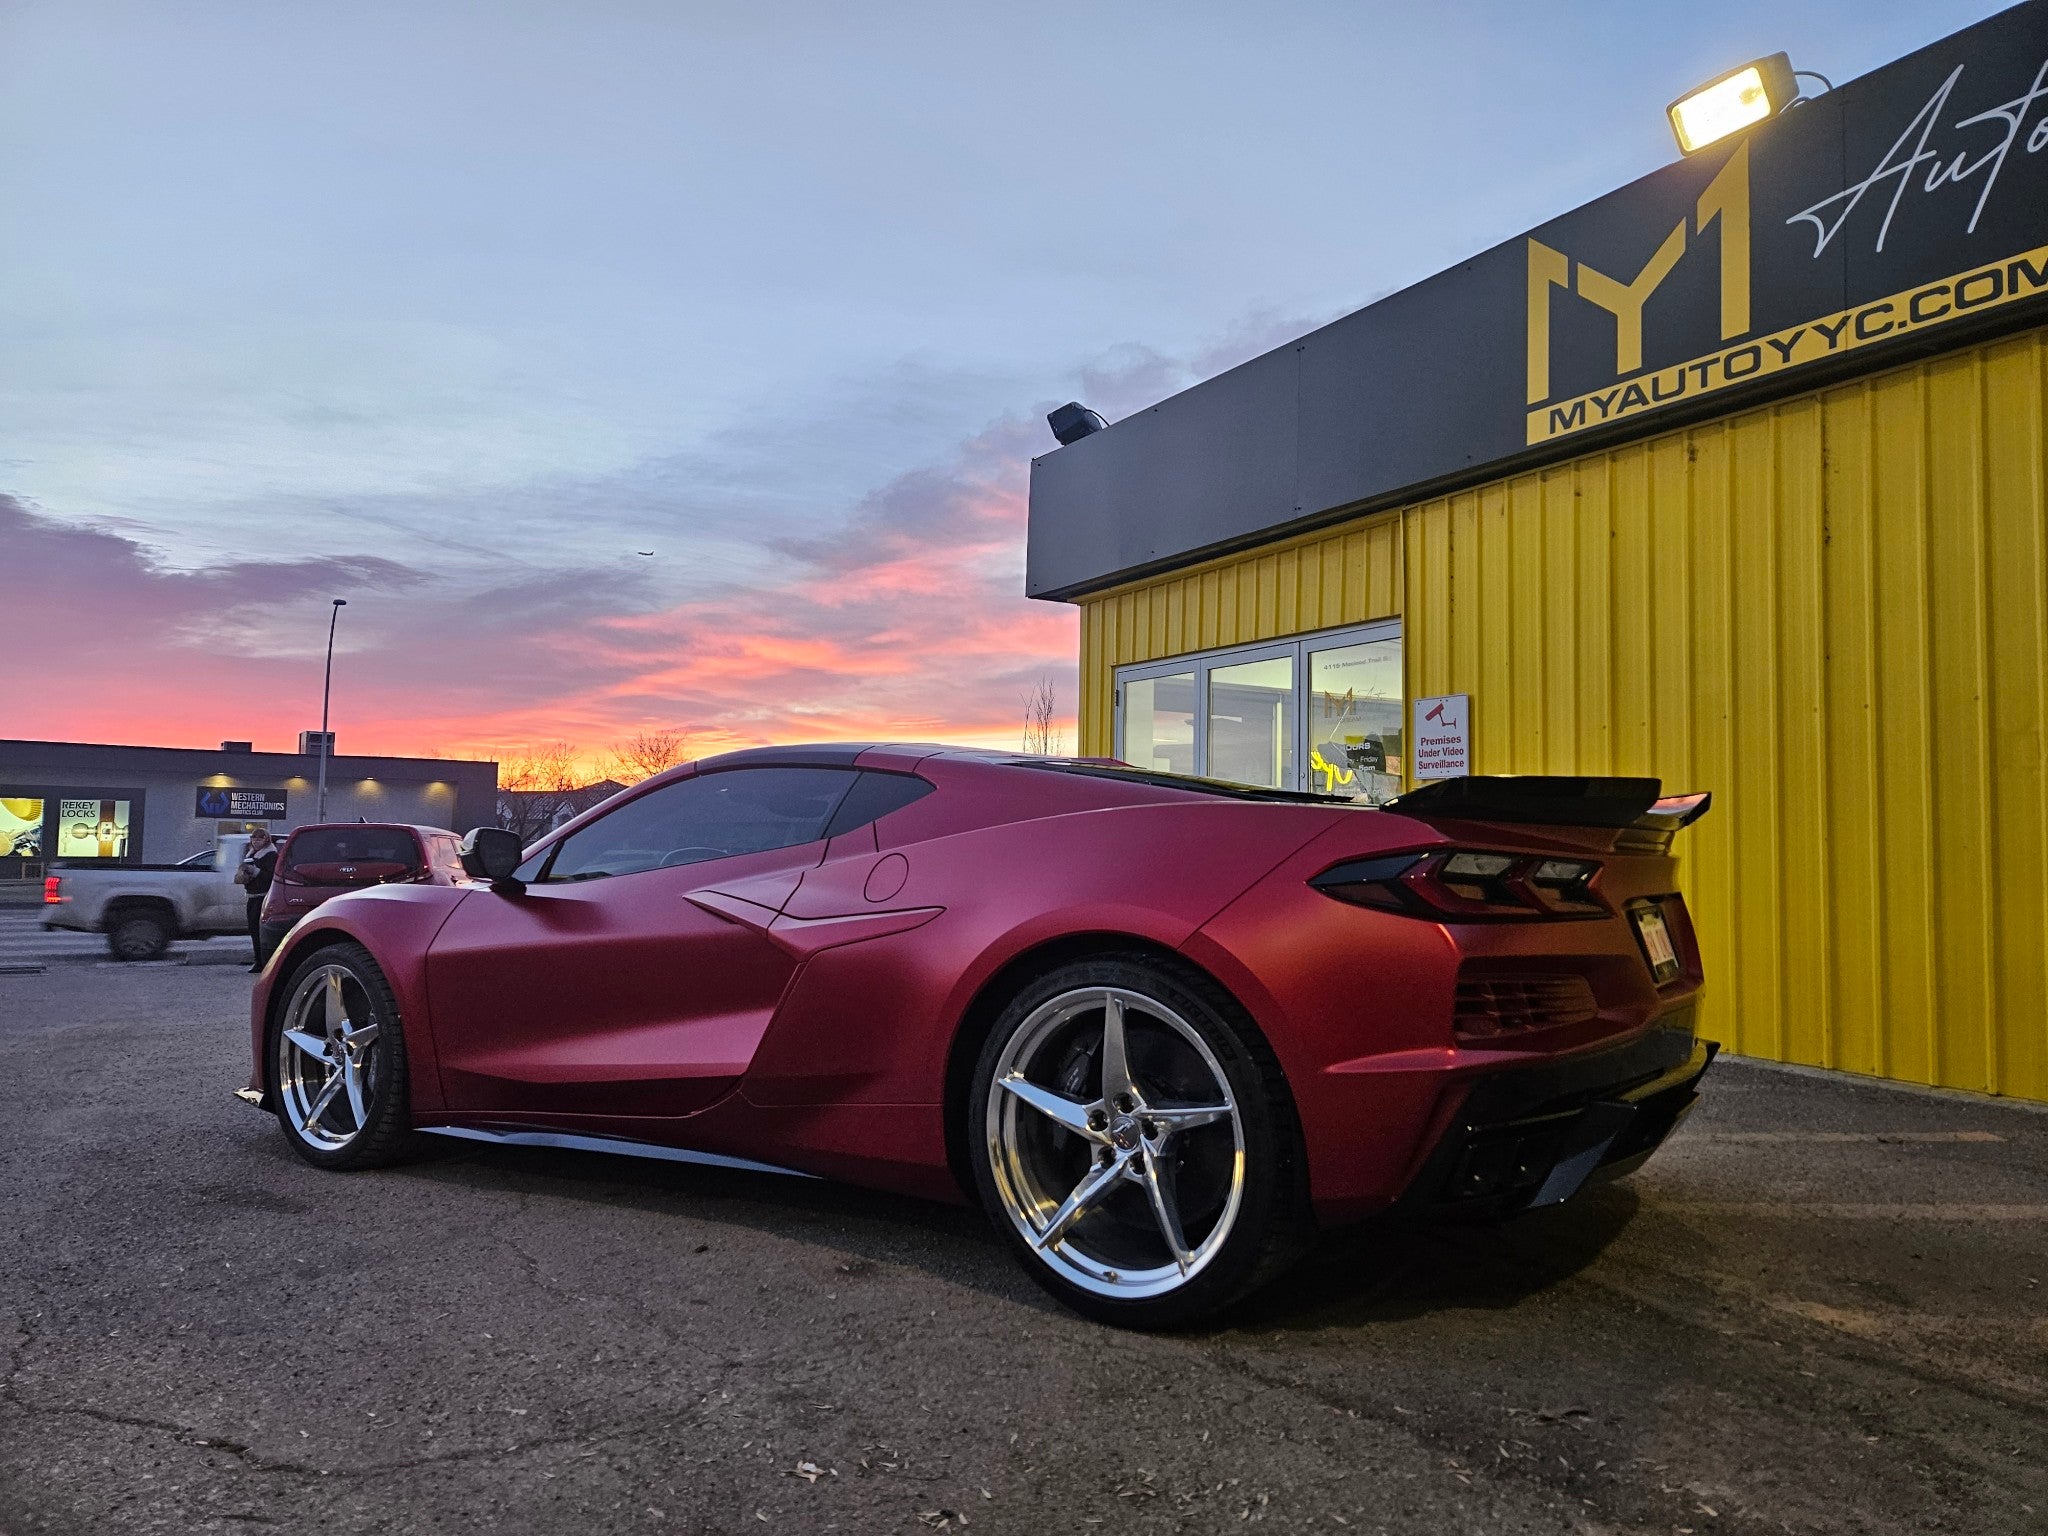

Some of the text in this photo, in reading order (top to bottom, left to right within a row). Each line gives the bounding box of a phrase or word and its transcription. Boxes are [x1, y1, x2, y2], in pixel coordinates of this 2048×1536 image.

[1548, 257, 2048, 435] MYAUTOYYC.COM
[1420, 735, 1462, 746] Premises
[1418, 746, 1464, 758] Under Video
[1418, 760, 1465, 770] Surveillance
[231, 792, 265, 801] WESTERN
[62, 801, 95, 809] REKEY
[230, 801, 285, 811] MECHATRONICS
[61, 810, 96, 818] LOCKS
